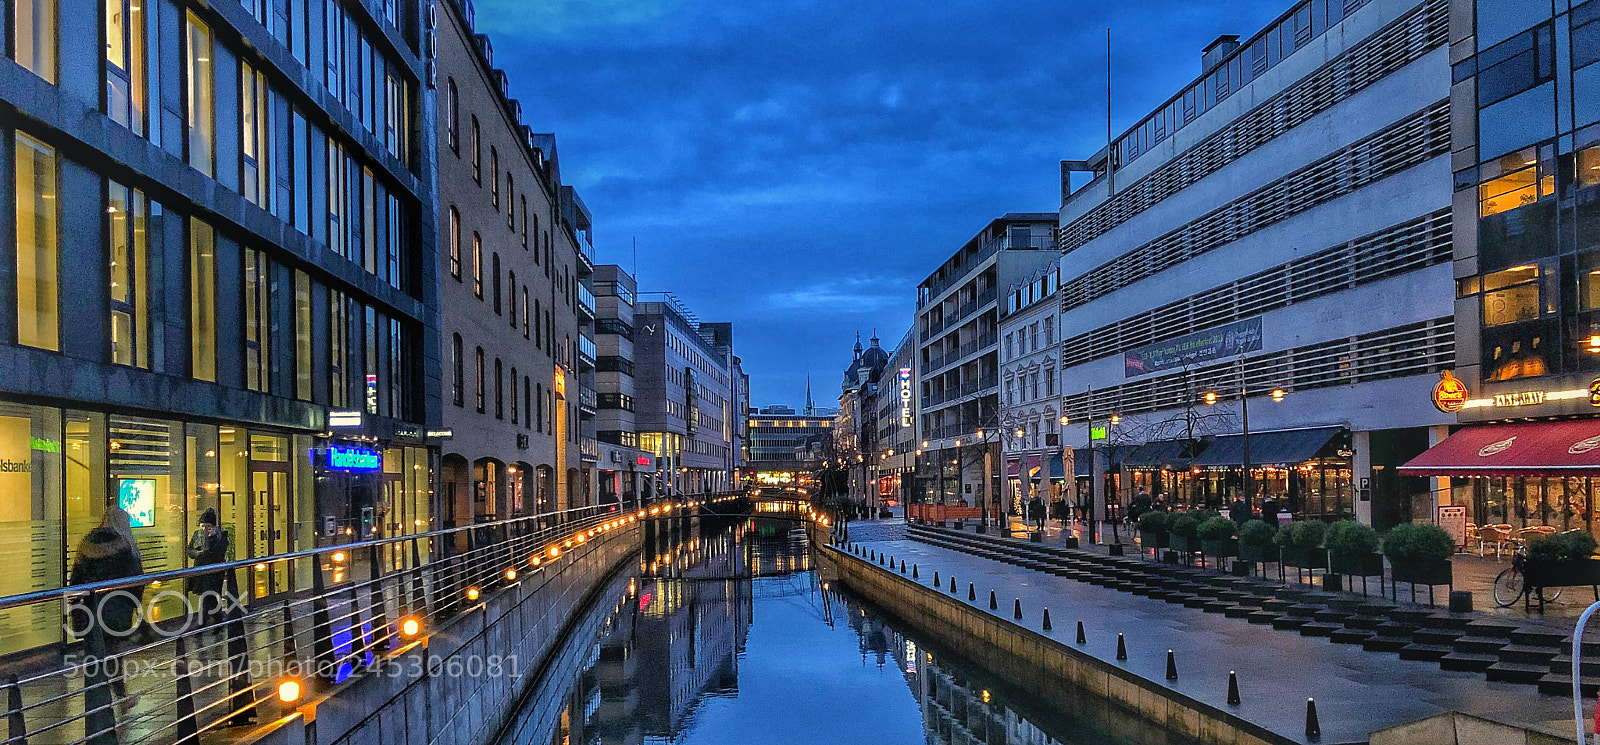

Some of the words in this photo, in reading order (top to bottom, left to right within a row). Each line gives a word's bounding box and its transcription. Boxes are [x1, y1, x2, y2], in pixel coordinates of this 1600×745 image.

[900, 379, 911, 428] HOTEL
[330, 446, 378, 469] Handelsbanken
[1361, 478, 1369, 489] P
